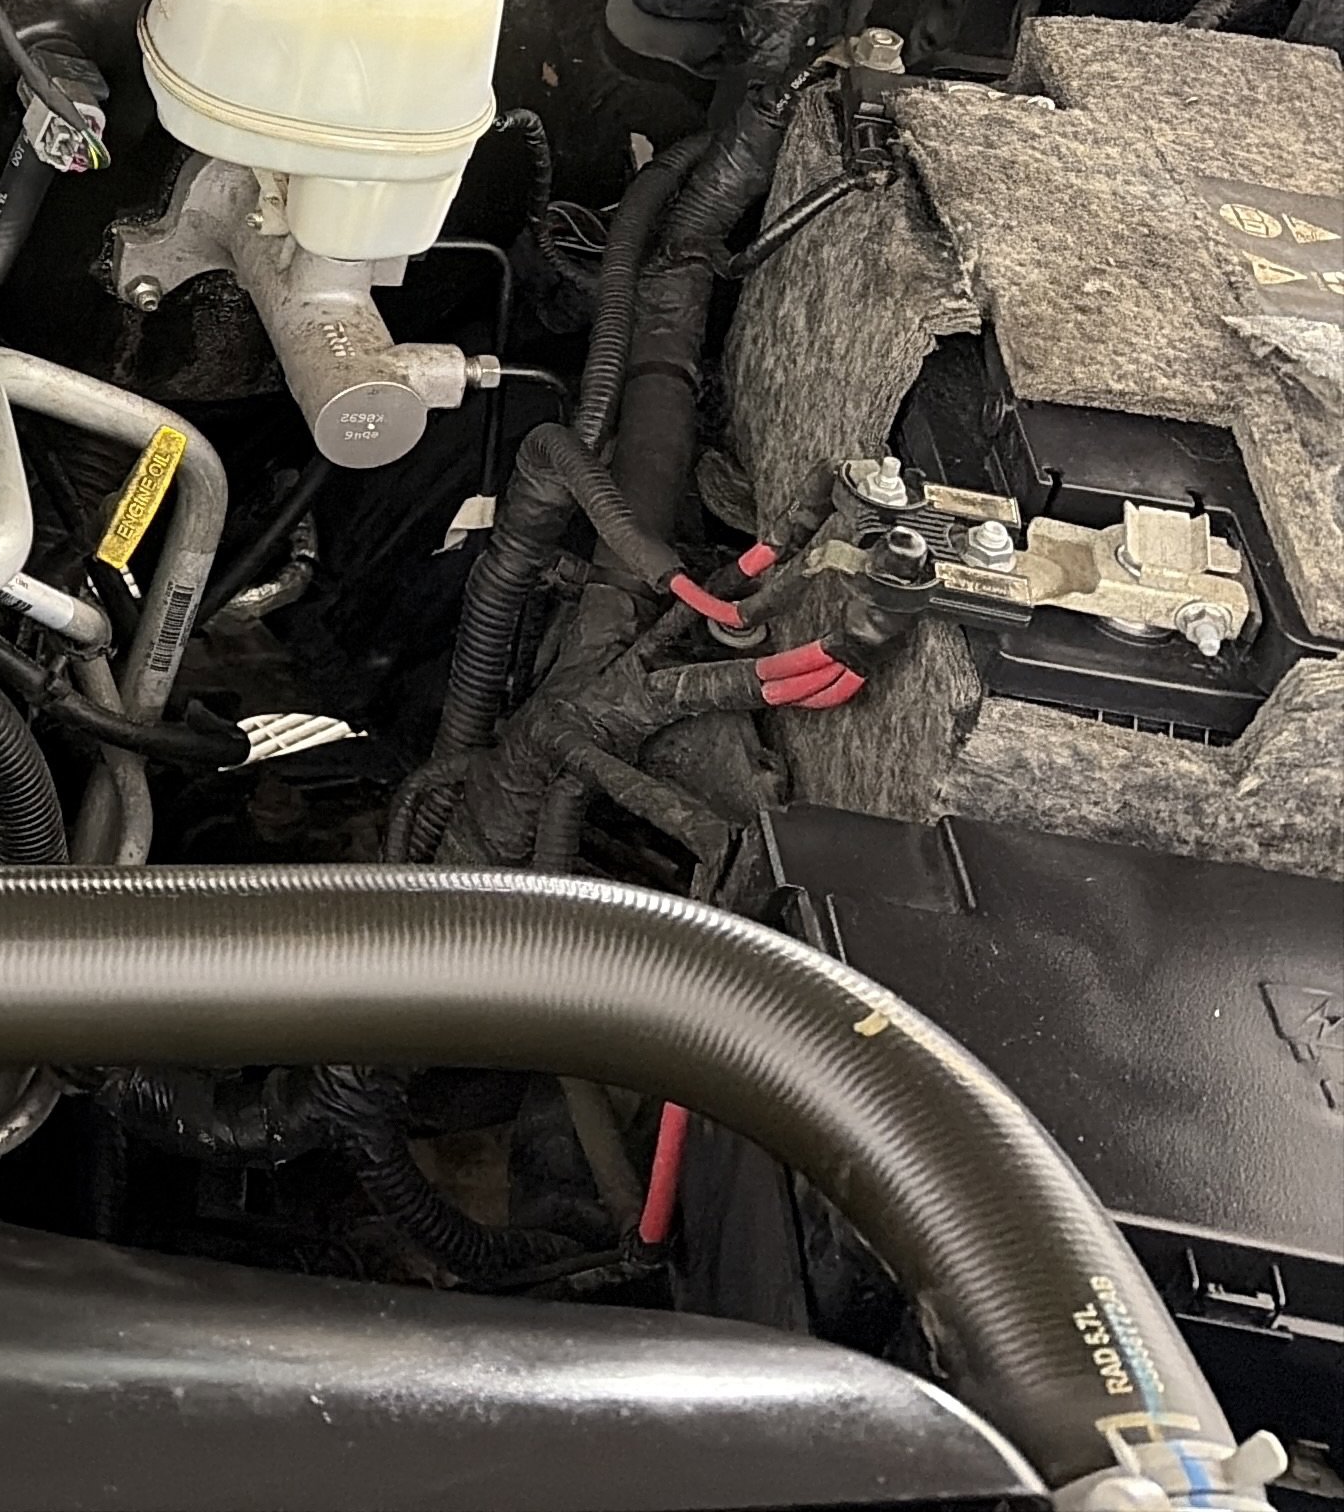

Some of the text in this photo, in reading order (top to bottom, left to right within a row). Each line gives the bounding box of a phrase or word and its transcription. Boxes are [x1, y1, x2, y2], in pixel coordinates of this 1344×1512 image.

[117, 452, 171, 539] ENGINE OIL
[1072, 1302, 1111, 1345] 5.7L
[1093, 1347, 1134, 1395] RAD
